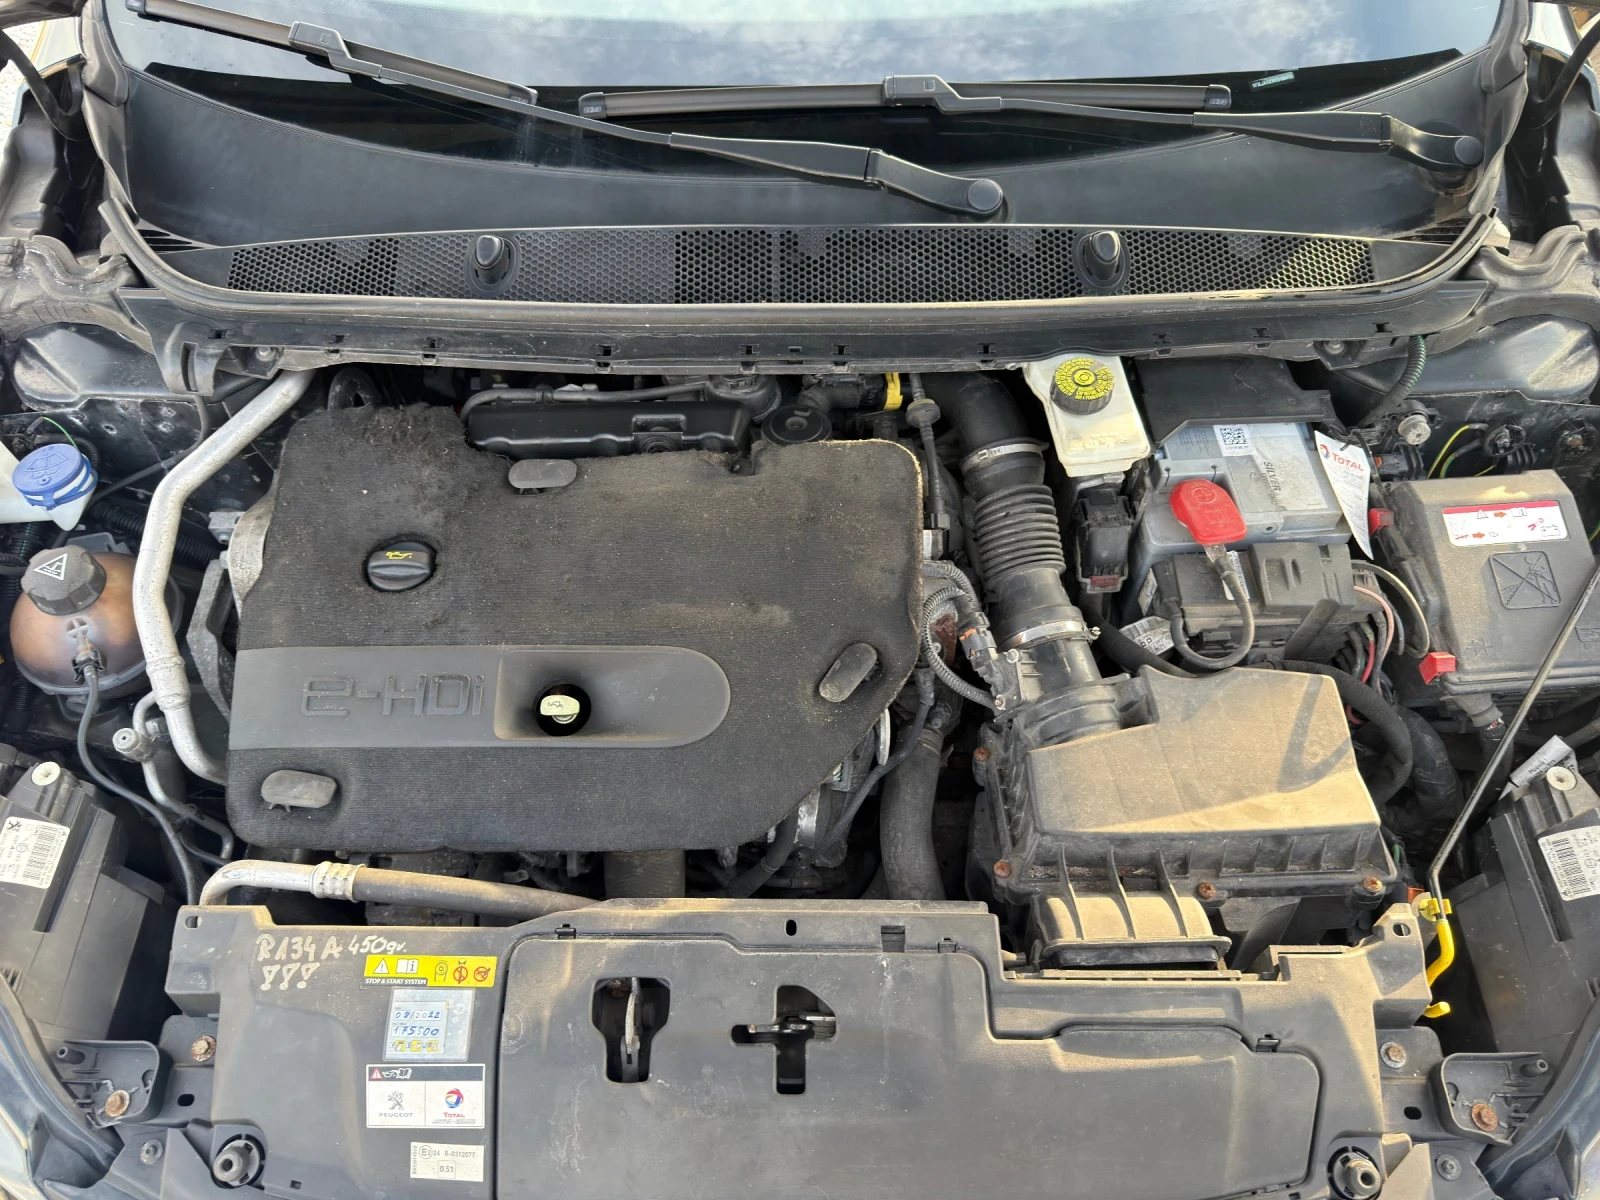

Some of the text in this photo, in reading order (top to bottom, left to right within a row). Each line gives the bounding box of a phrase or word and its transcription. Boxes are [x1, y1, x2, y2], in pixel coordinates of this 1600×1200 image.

[1332, 452, 1365, 472] TOTAL
[1264, 461, 1281, 491] SILVER
[301, 674, 484, 717] e-HDi
[404, 978, 427, 986] SYSTEM
[439, 1165, 454, 1173] 0.51
